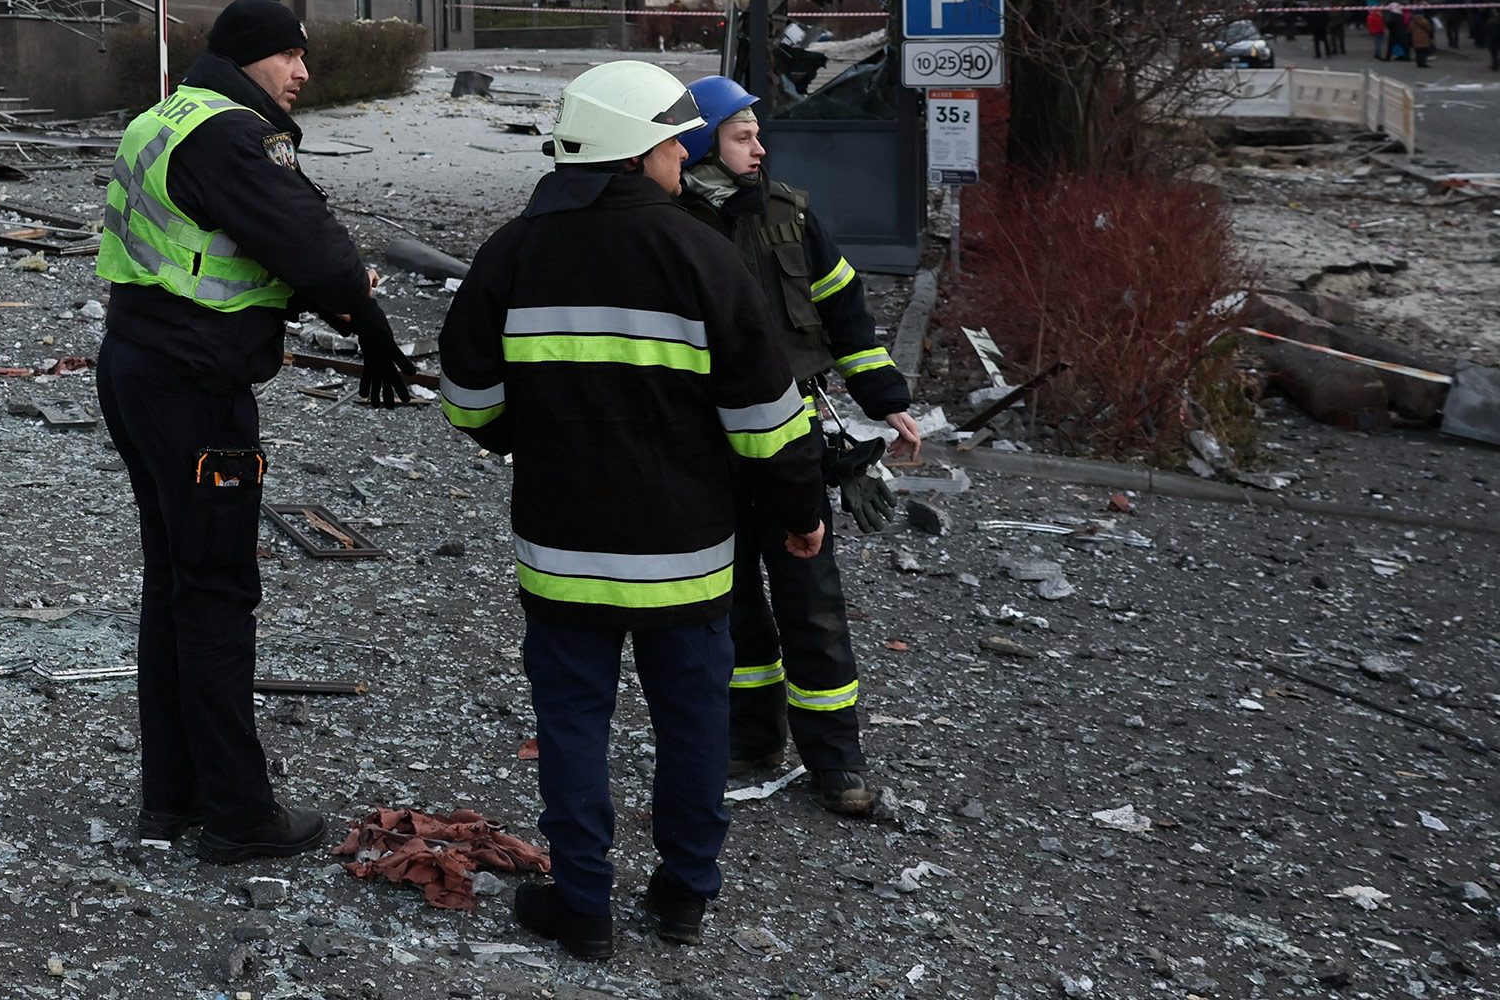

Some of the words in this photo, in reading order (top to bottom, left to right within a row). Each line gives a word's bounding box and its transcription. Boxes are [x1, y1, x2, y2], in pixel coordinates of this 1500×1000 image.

[917, 57, 931, 70] 10
[938, 56, 957, 70] 25
[962, 54, 987, 72] 50
[936, 106, 960, 123] 35
